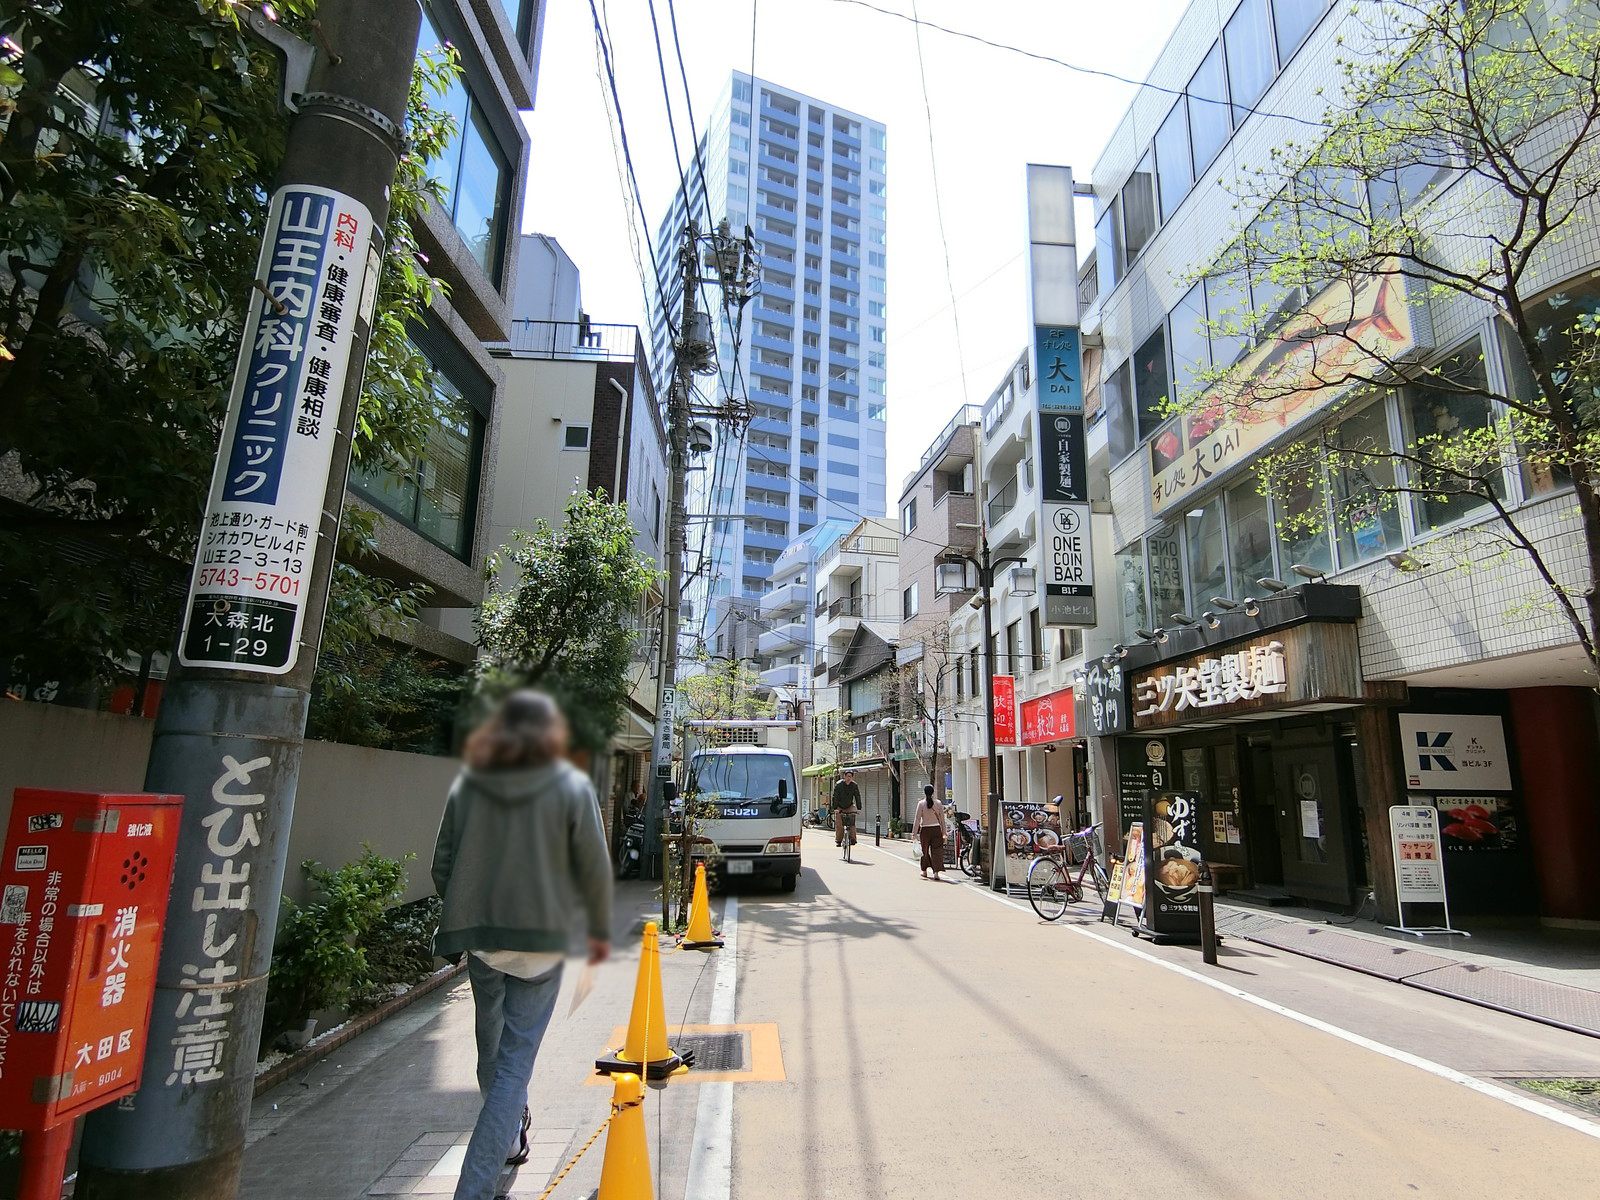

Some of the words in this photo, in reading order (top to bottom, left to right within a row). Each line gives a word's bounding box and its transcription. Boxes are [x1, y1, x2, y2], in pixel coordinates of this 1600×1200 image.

[233, 197, 329, 496] 山王内科クリニック
[1042, 341, 1072, 351] すし処
[1047, 356, 1075, 382] 大
[1050, 385, 1070, 393] DAI
[1153, 467, 1186, 503] すし処
[1191, 447, 1212, 486] 大
[1213, 428, 1240, 463] DAI
[209, 512, 309, 539] 池上通り・ガード前
[206, 531, 306, 555] シオカワビル4F
[1053, 536, 1081, 552] ONE
[202, 550, 303, 574] 山王2-3-13
[1053, 553, 1082, 566] COIN
[199, 568, 300, 597] 5743-5701
[1054, 566, 1083, 582] BAR
[1061, 587, 1078, 595] B1F
[204, 606, 274, 633] 大森北
[1051, 605, 1091, 616] 小池ビル
[203, 635, 268, 657] 1-29
[1136, 640, 1287, 717] 三ツ矢堂製麺
[723, 808, 759, 816] ISUZU
[126, 823, 153, 838] 強化液
[1401, 842, 1433, 850] マッサージ
[1404, 852, 1432, 860] 治療室
[27, 871, 63, 995] 非常の場合以外は
[165, 755, 271, 1087] とび出し注意
[101, 906, 139, 1008] 消火器
[75, 1028, 134, 1070] 大田区
